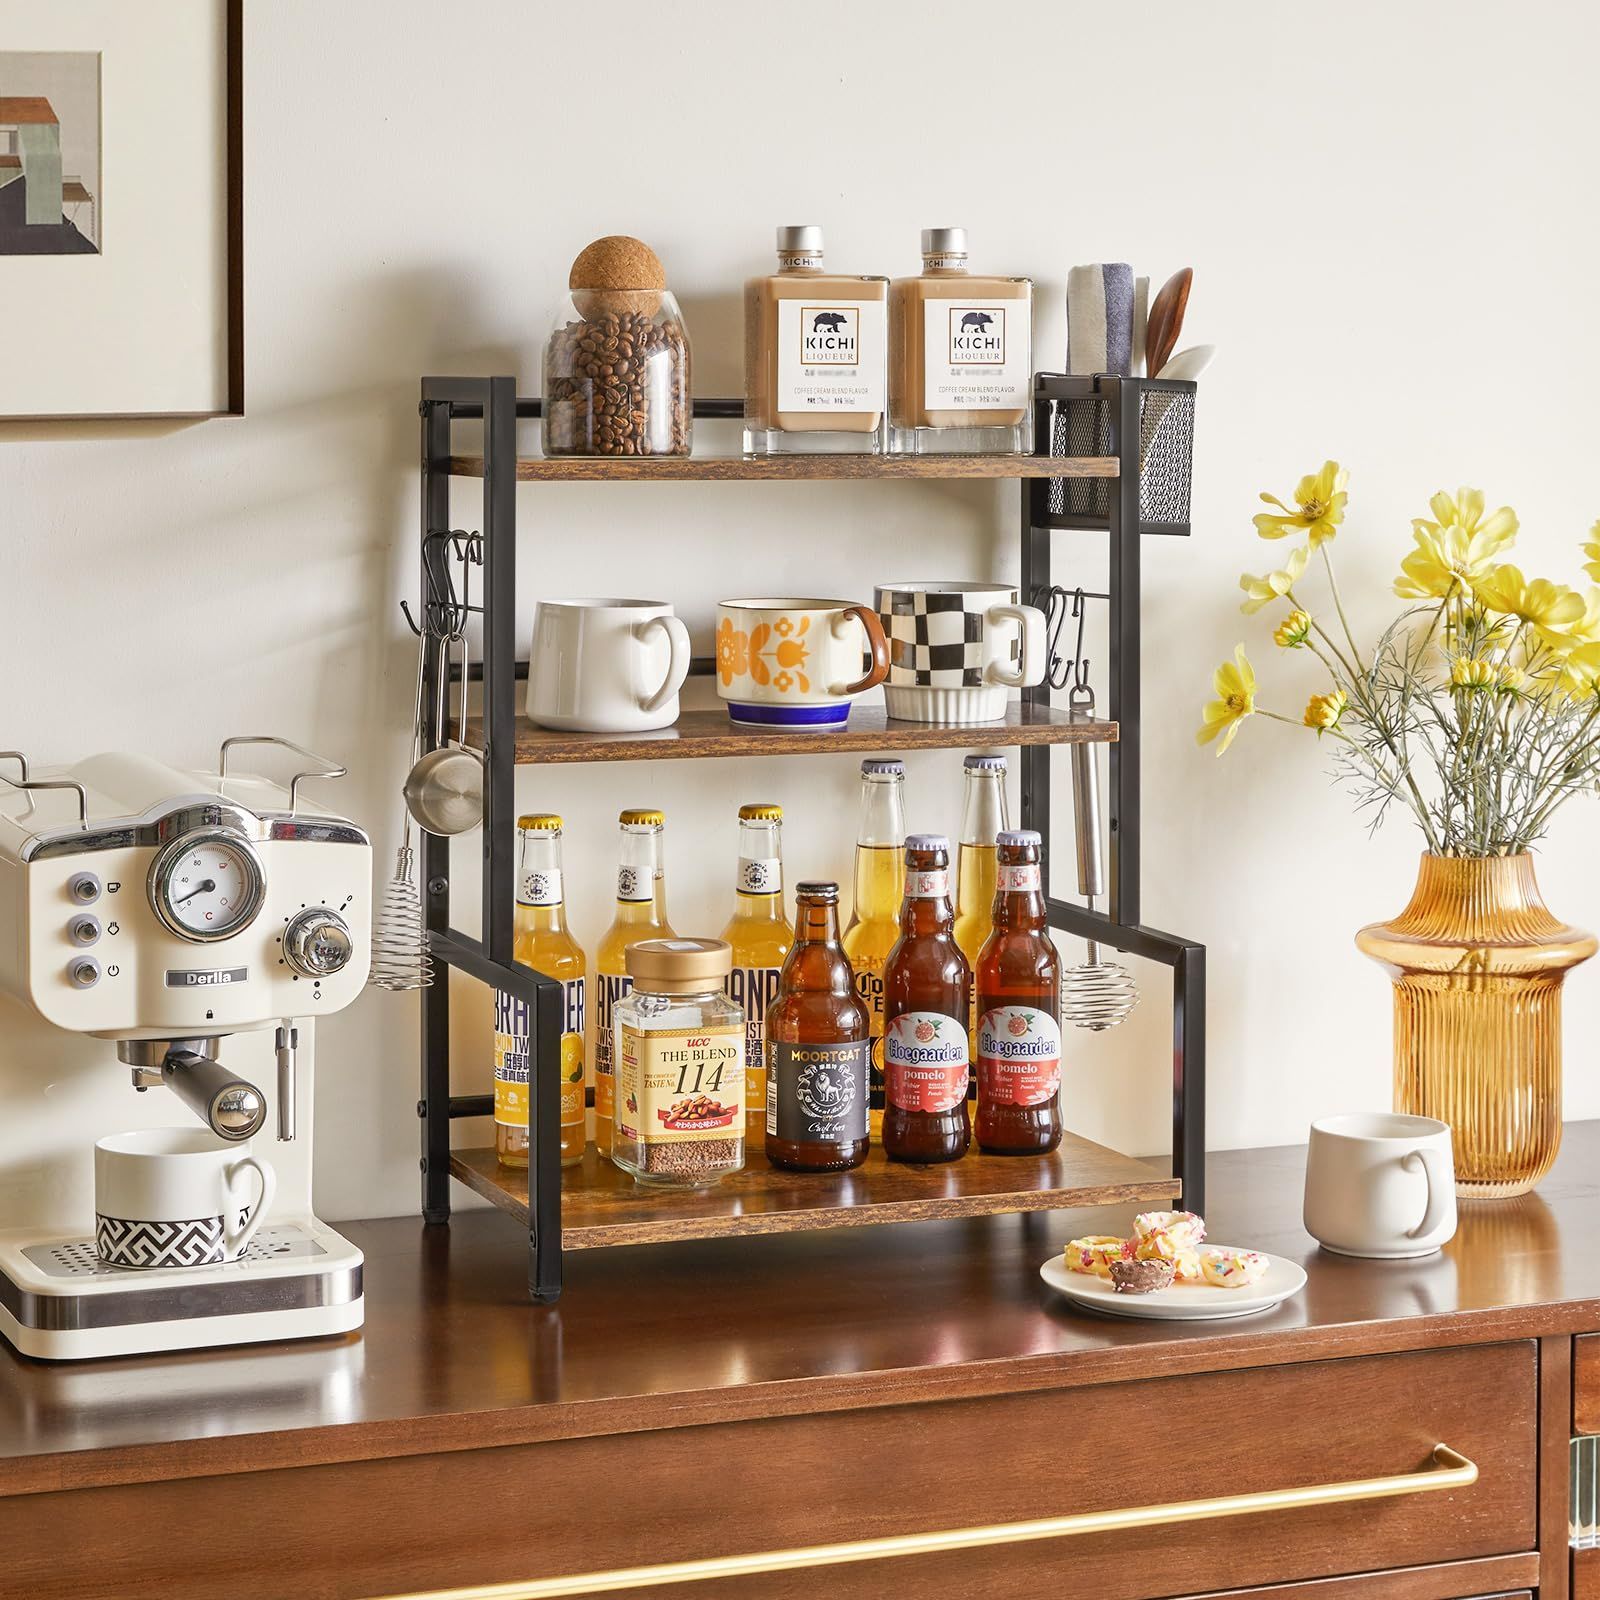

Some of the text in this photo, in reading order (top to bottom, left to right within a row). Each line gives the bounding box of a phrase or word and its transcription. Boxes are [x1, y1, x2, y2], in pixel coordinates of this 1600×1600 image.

[806, 337, 854, 349] KICHI
[953, 337, 1000, 349] KICHI
[806, 352, 854, 361] LIQUEUR
[954, 352, 1000, 360] LIQUEUR
[181, 876, 189, 884] 40
[186, 899, 192, 907] 0
[889, 1038, 963, 1064] Hoegaarden
[982, 1032, 1056, 1058] Hoegaarden
[660, 1047, 737, 1062] THE BLEND
[791, 1048, 861, 1062] MOORTGAT
[904, 1069, 945, 1080] pomelo
[996, 1063, 1038, 1074] pomelo
[672, 1061, 725, 1095] 114
